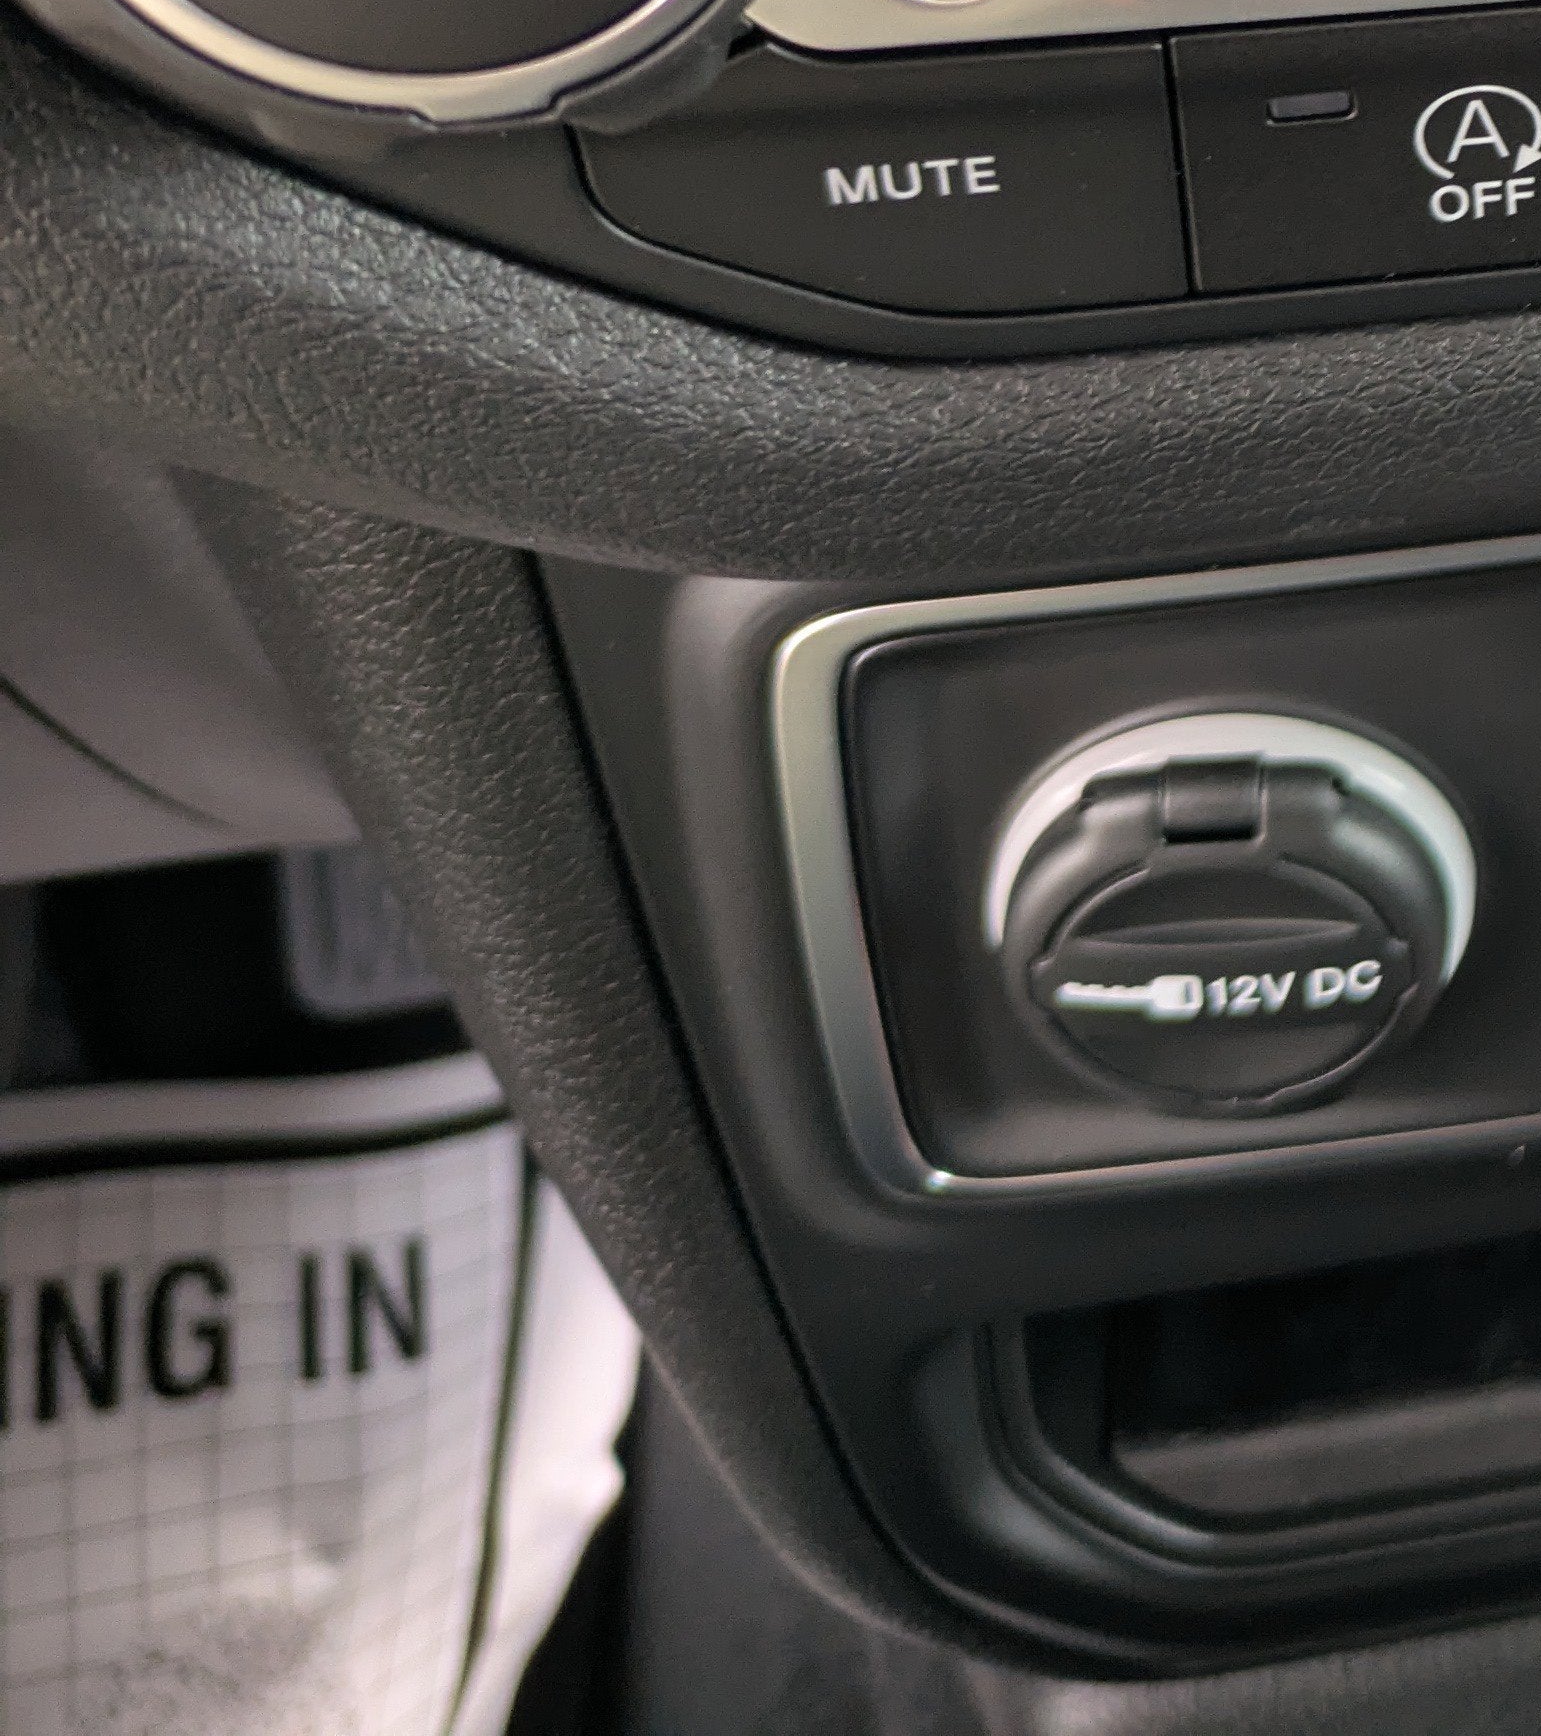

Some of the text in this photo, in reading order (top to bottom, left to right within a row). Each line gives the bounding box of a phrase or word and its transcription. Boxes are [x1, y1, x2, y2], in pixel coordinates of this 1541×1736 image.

[824, 155, 1001, 206] MUTE
[1428, 176, 1536, 223] OFF
[1205, 959, 1384, 1017] 12V DC
[299, 1234, 430, 1381] IN
